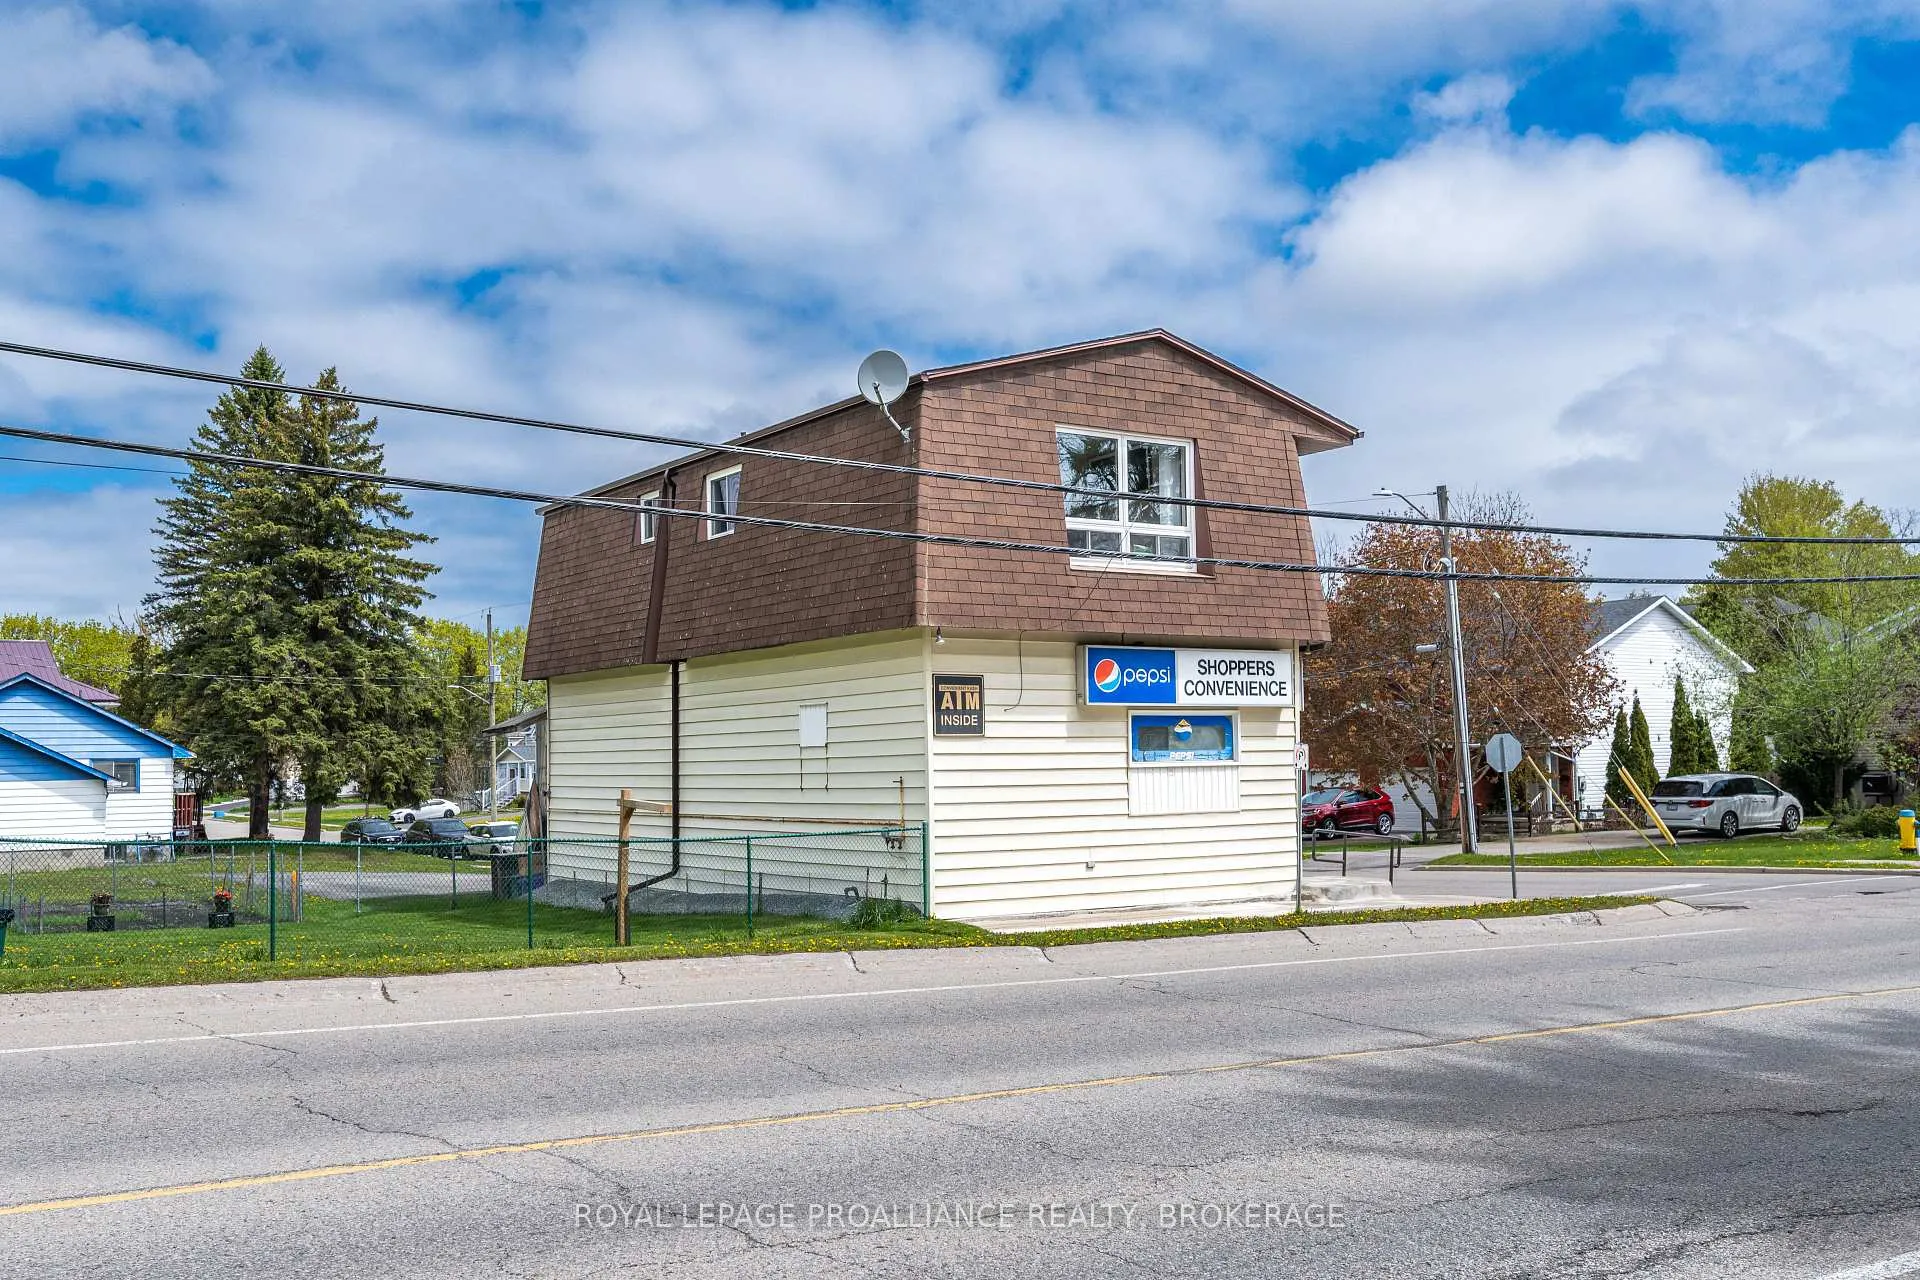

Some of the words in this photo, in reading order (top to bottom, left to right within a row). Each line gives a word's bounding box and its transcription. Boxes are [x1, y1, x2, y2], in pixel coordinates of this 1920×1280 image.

[1123, 666, 1171, 686] pepsi
[1197, 659, 1275, 676] SHOPPERS
[1184, 680, 1287, 696] CONVENIENCE
[940, 688, 980, 710] ATM
[941, 714, 978, 726] INSIDE
